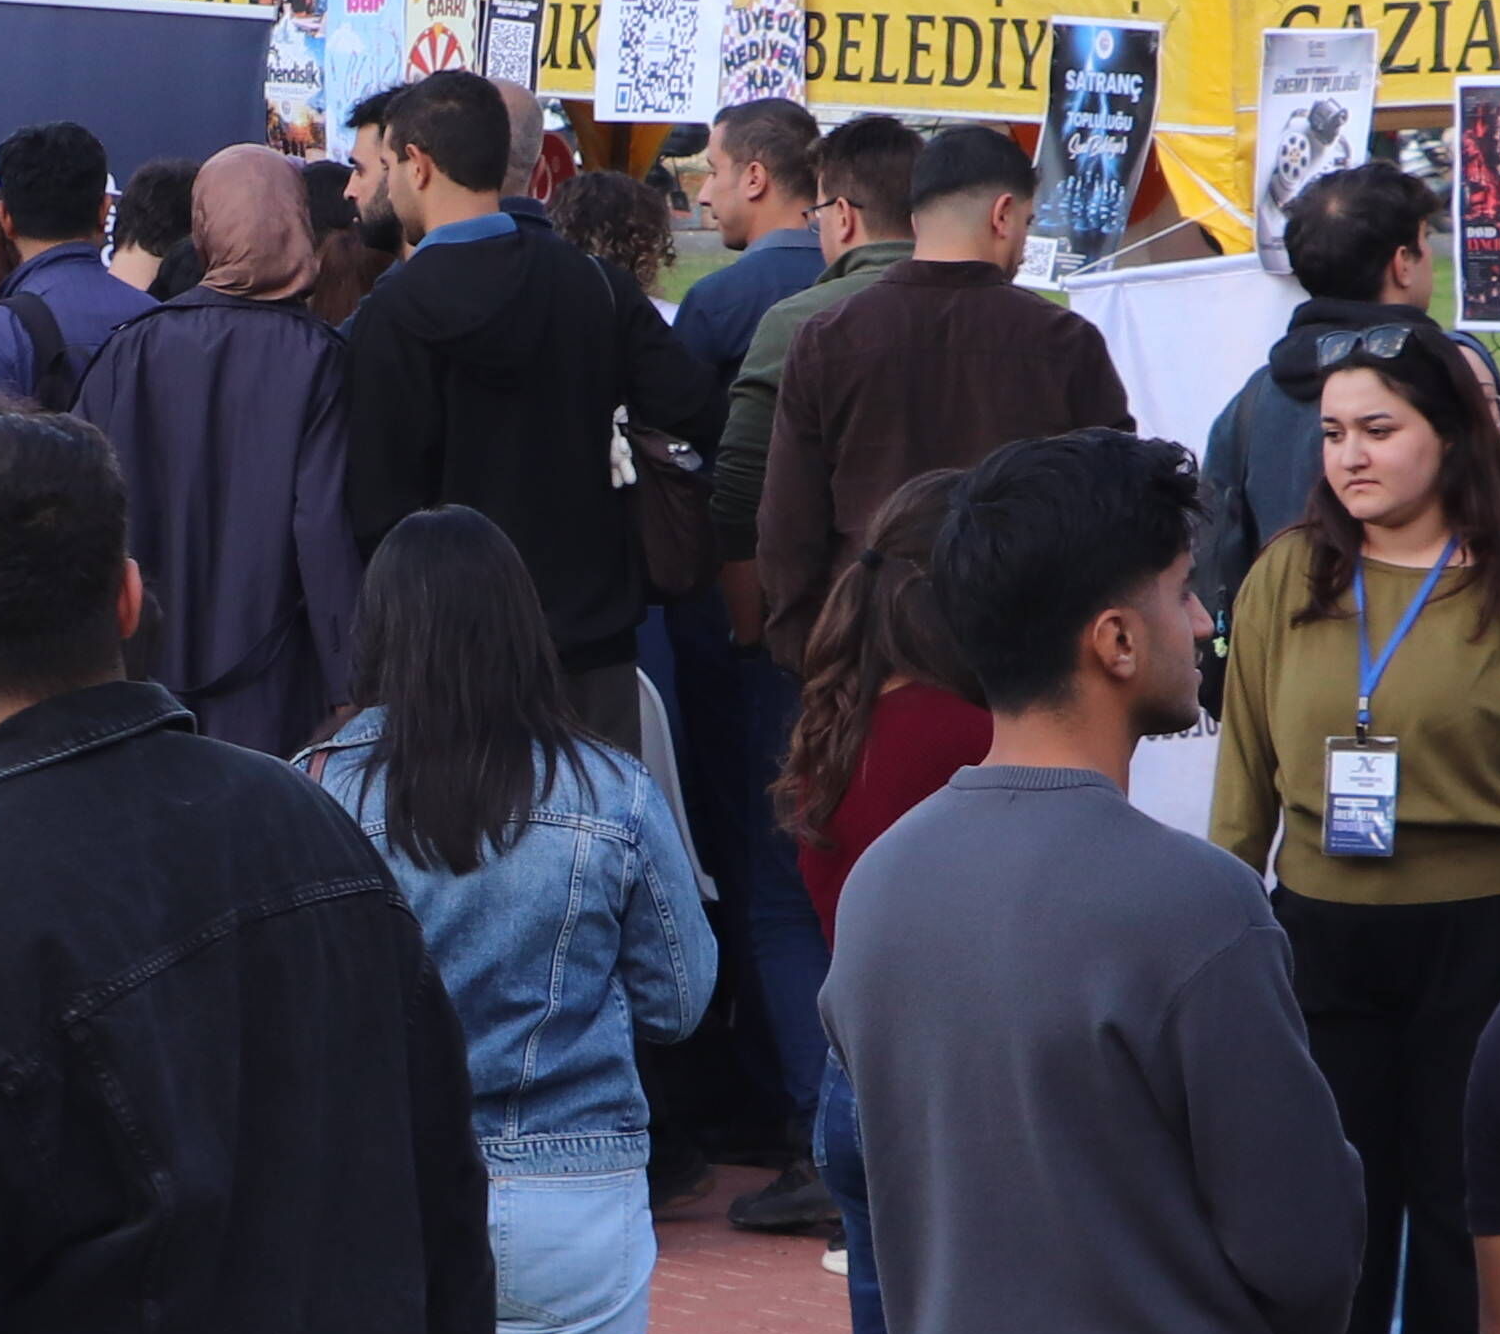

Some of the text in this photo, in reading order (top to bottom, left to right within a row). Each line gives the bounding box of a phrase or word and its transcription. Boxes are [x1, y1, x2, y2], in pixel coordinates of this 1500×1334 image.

[737, 7, 801, 42] ÜYE OL
[747, 65, 783, 91] KAP
[1065, 69, 1144, 103] SATRANÇ
[1067, 109, 1133, 132] TOPLULUĞU
